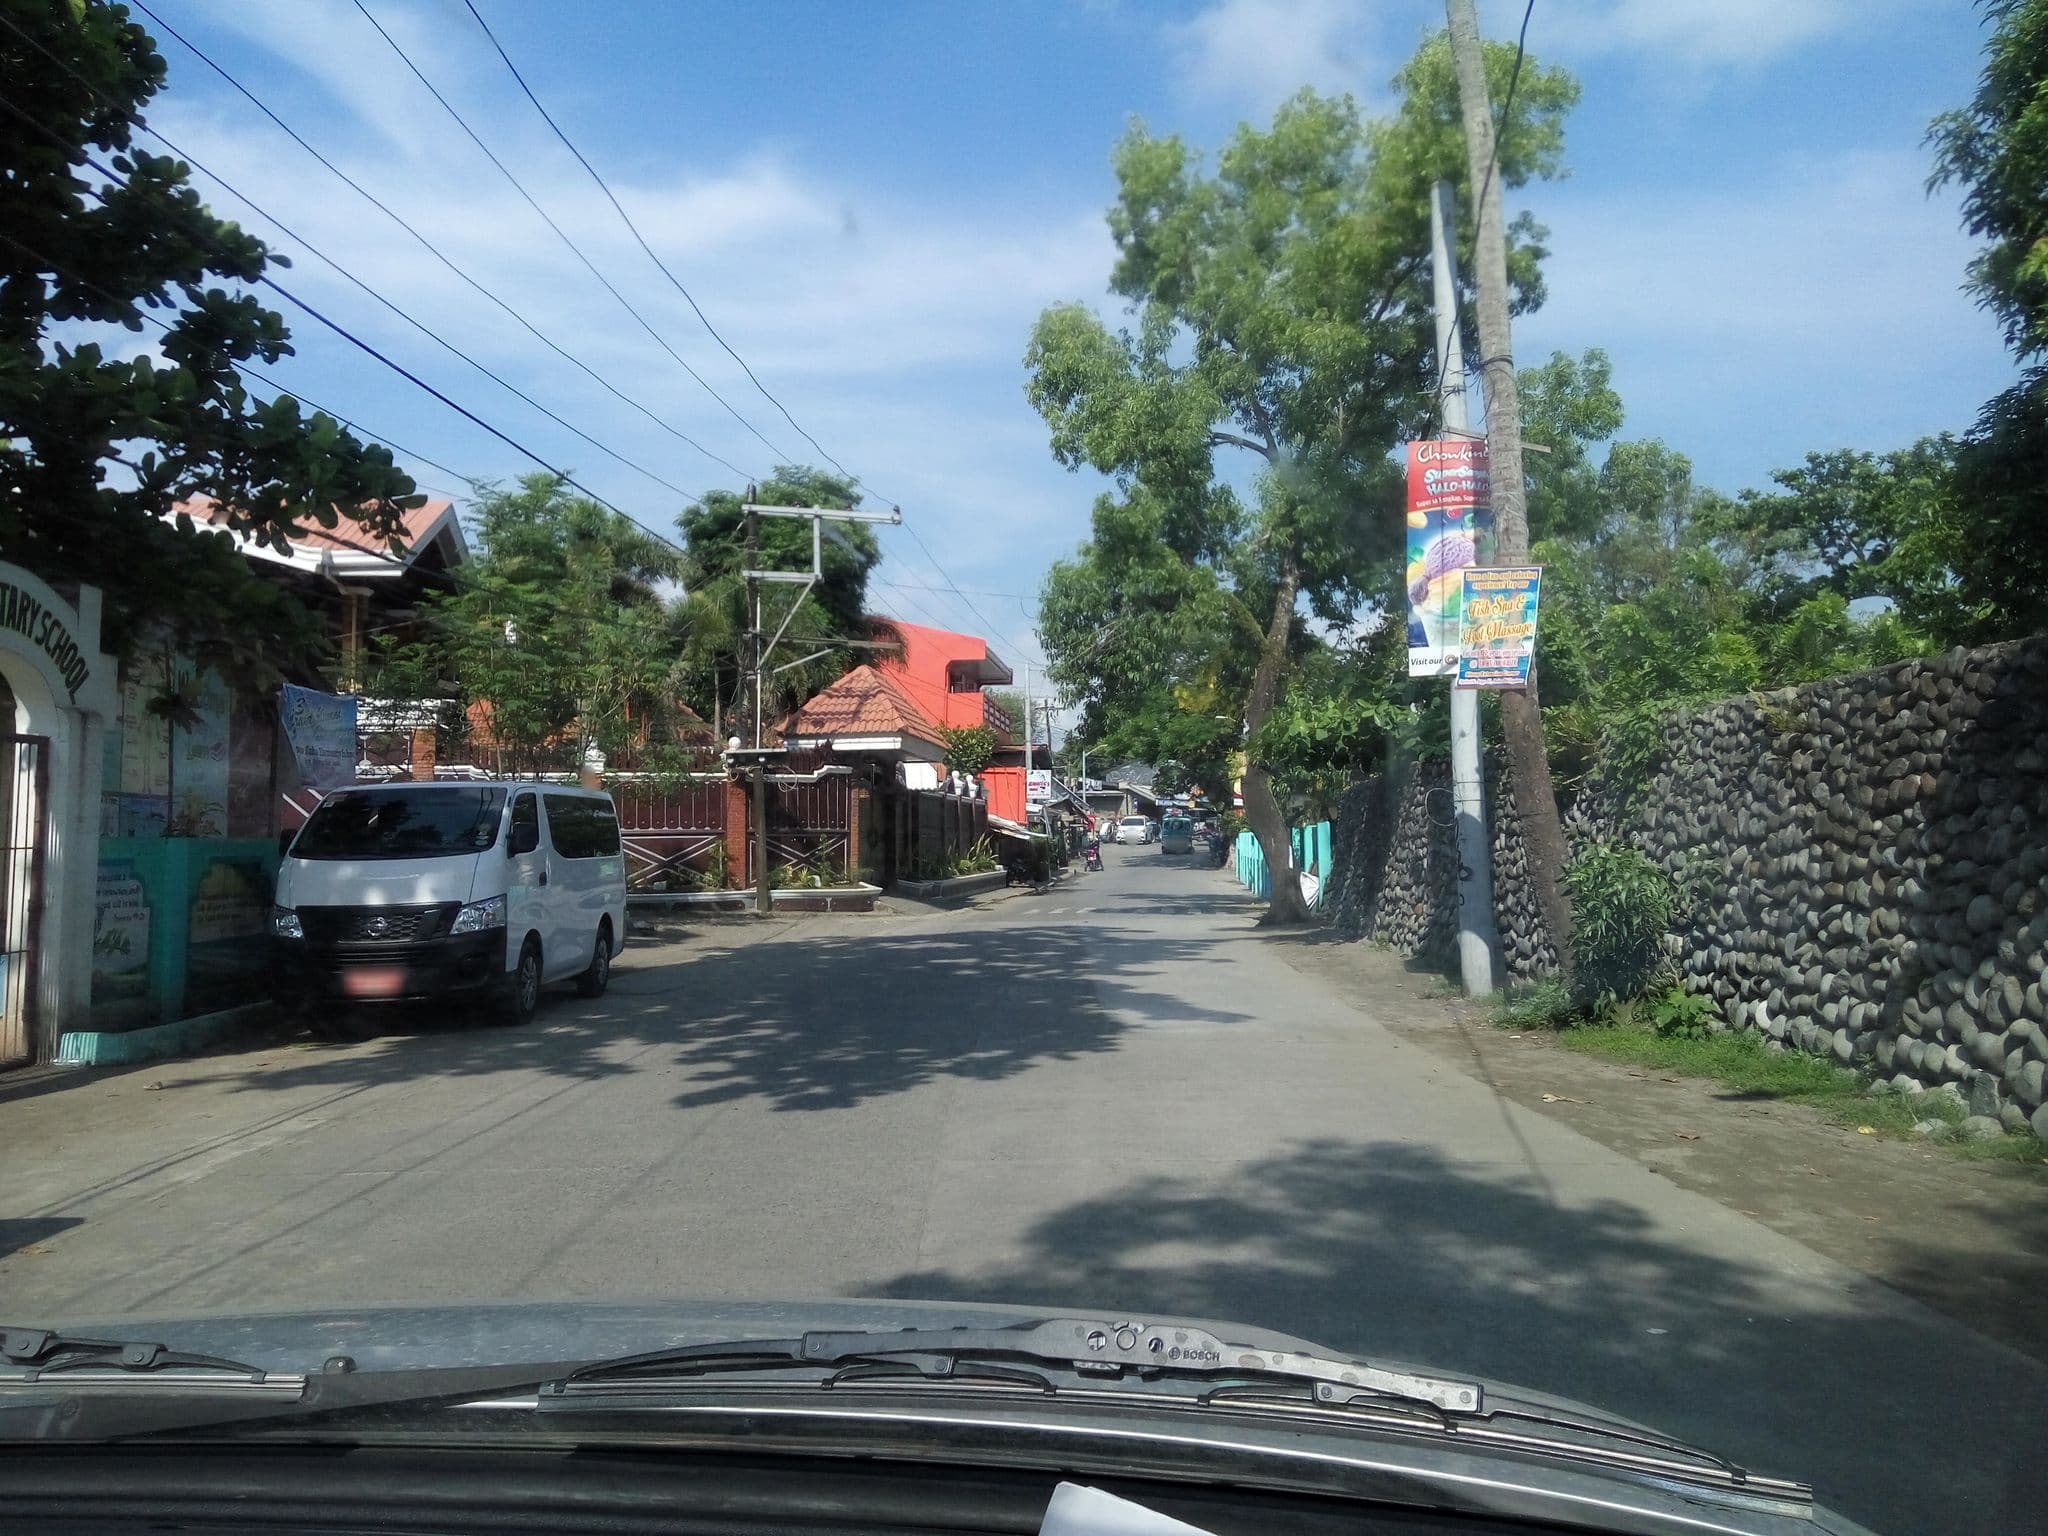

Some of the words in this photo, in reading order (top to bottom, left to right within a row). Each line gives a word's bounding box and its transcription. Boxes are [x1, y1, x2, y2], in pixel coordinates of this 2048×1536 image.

[1468, 598, 1489, 620] Fish
[1491, 595, 1513, 616] Spa
[1486, 621, 1532, 640] Massage
[34, 609, 91, 705] SCHOOL
[1411, 658, 1427, 666] Visit
[1183, 1350, 1220, 1362] BOSCH
